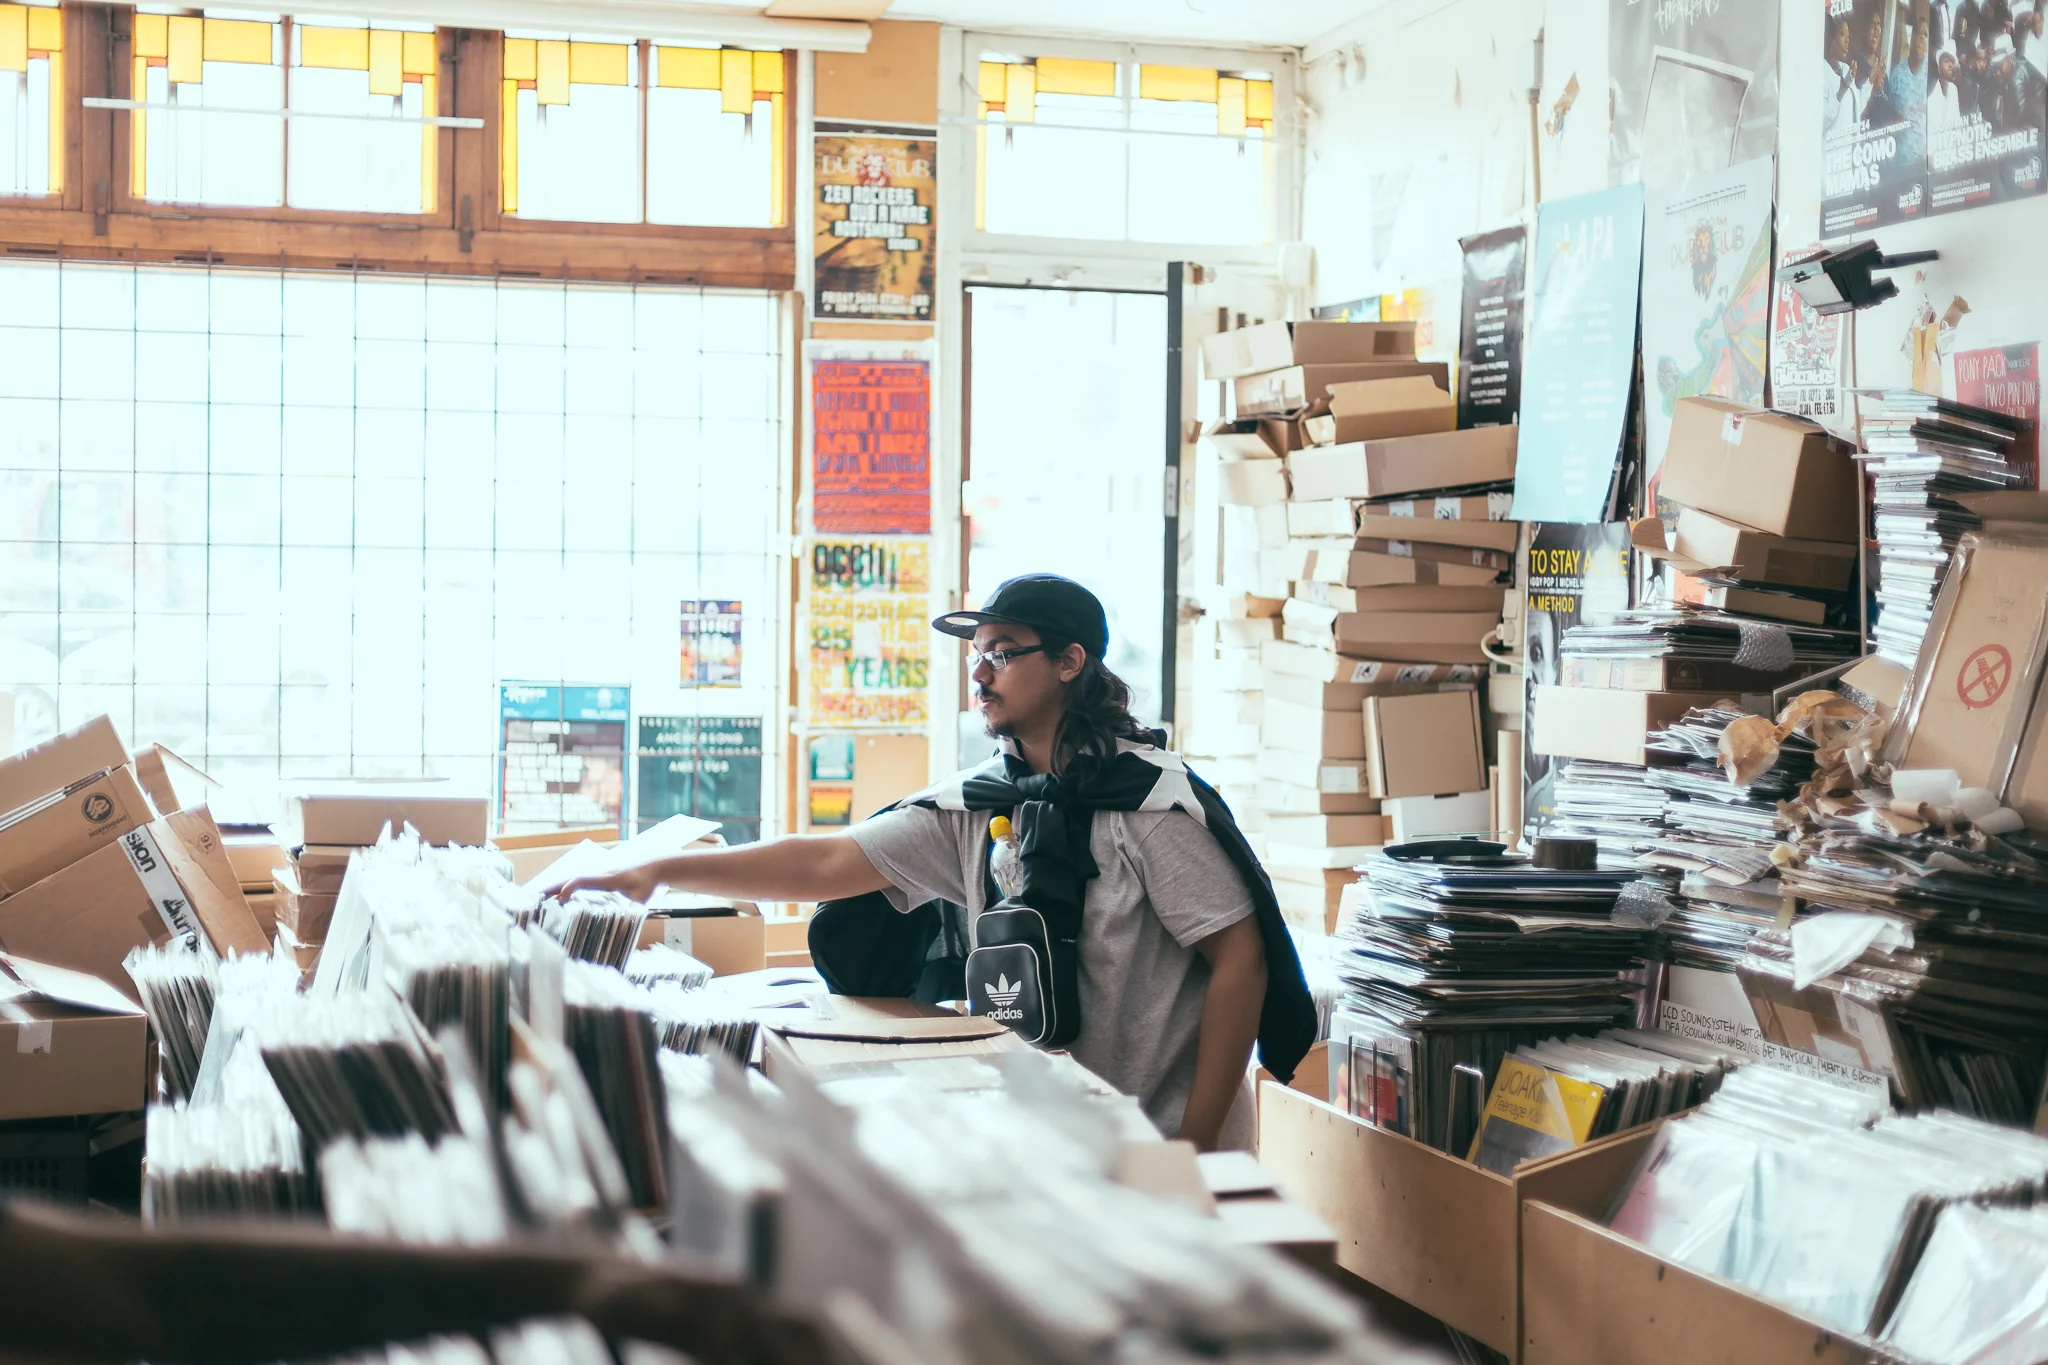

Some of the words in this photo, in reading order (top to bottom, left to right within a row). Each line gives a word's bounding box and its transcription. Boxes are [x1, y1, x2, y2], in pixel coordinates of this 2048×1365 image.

[1933, 122, 1993, 151] HYPNOTIC
[1934, 144, 1973, 170] BRASS
[1975, 128, 2039, 160] ENSEMBLE
[1825, 145, 1852, 174] THE
[1853, 136, 1896, 168] COMO
[1825, 163, 1880, 197] MAMAS
[824, 184, 852, 204] ZEN
[852, 186, 915, 206] ROCKERS
[1957, 356, 1981, 384] PONY
[1983, 353, 2007, 380] PACK
[1985, 382, 2006, 408] TWO
[2007, 381, 2021, 407] PIN
[2022, 379, 2036, 406] DIN
[1530, 549, 1548, 574] TO
[1550, 549, 1581, 575] STAY
[1582, 550, 1629, 575] ALIVE
[1543, 576, 1555, 588] POP
[1528, 595, 1535, 611] A
[1537, 595, 1575, 613] METHOD
[845, 656, 929, 689] YEARS
[88, 814, 128, 838] INDEPENDENT
[986, 1007, 1023, 1021] adidas
[1662, 1005, 1678, 1020] LCD
[1762, 1042, 1776, 1060] GET
[1851, 1068, 1883, 1089] GROOVE
[1493, 1094, 1527, 1121] Teenage
